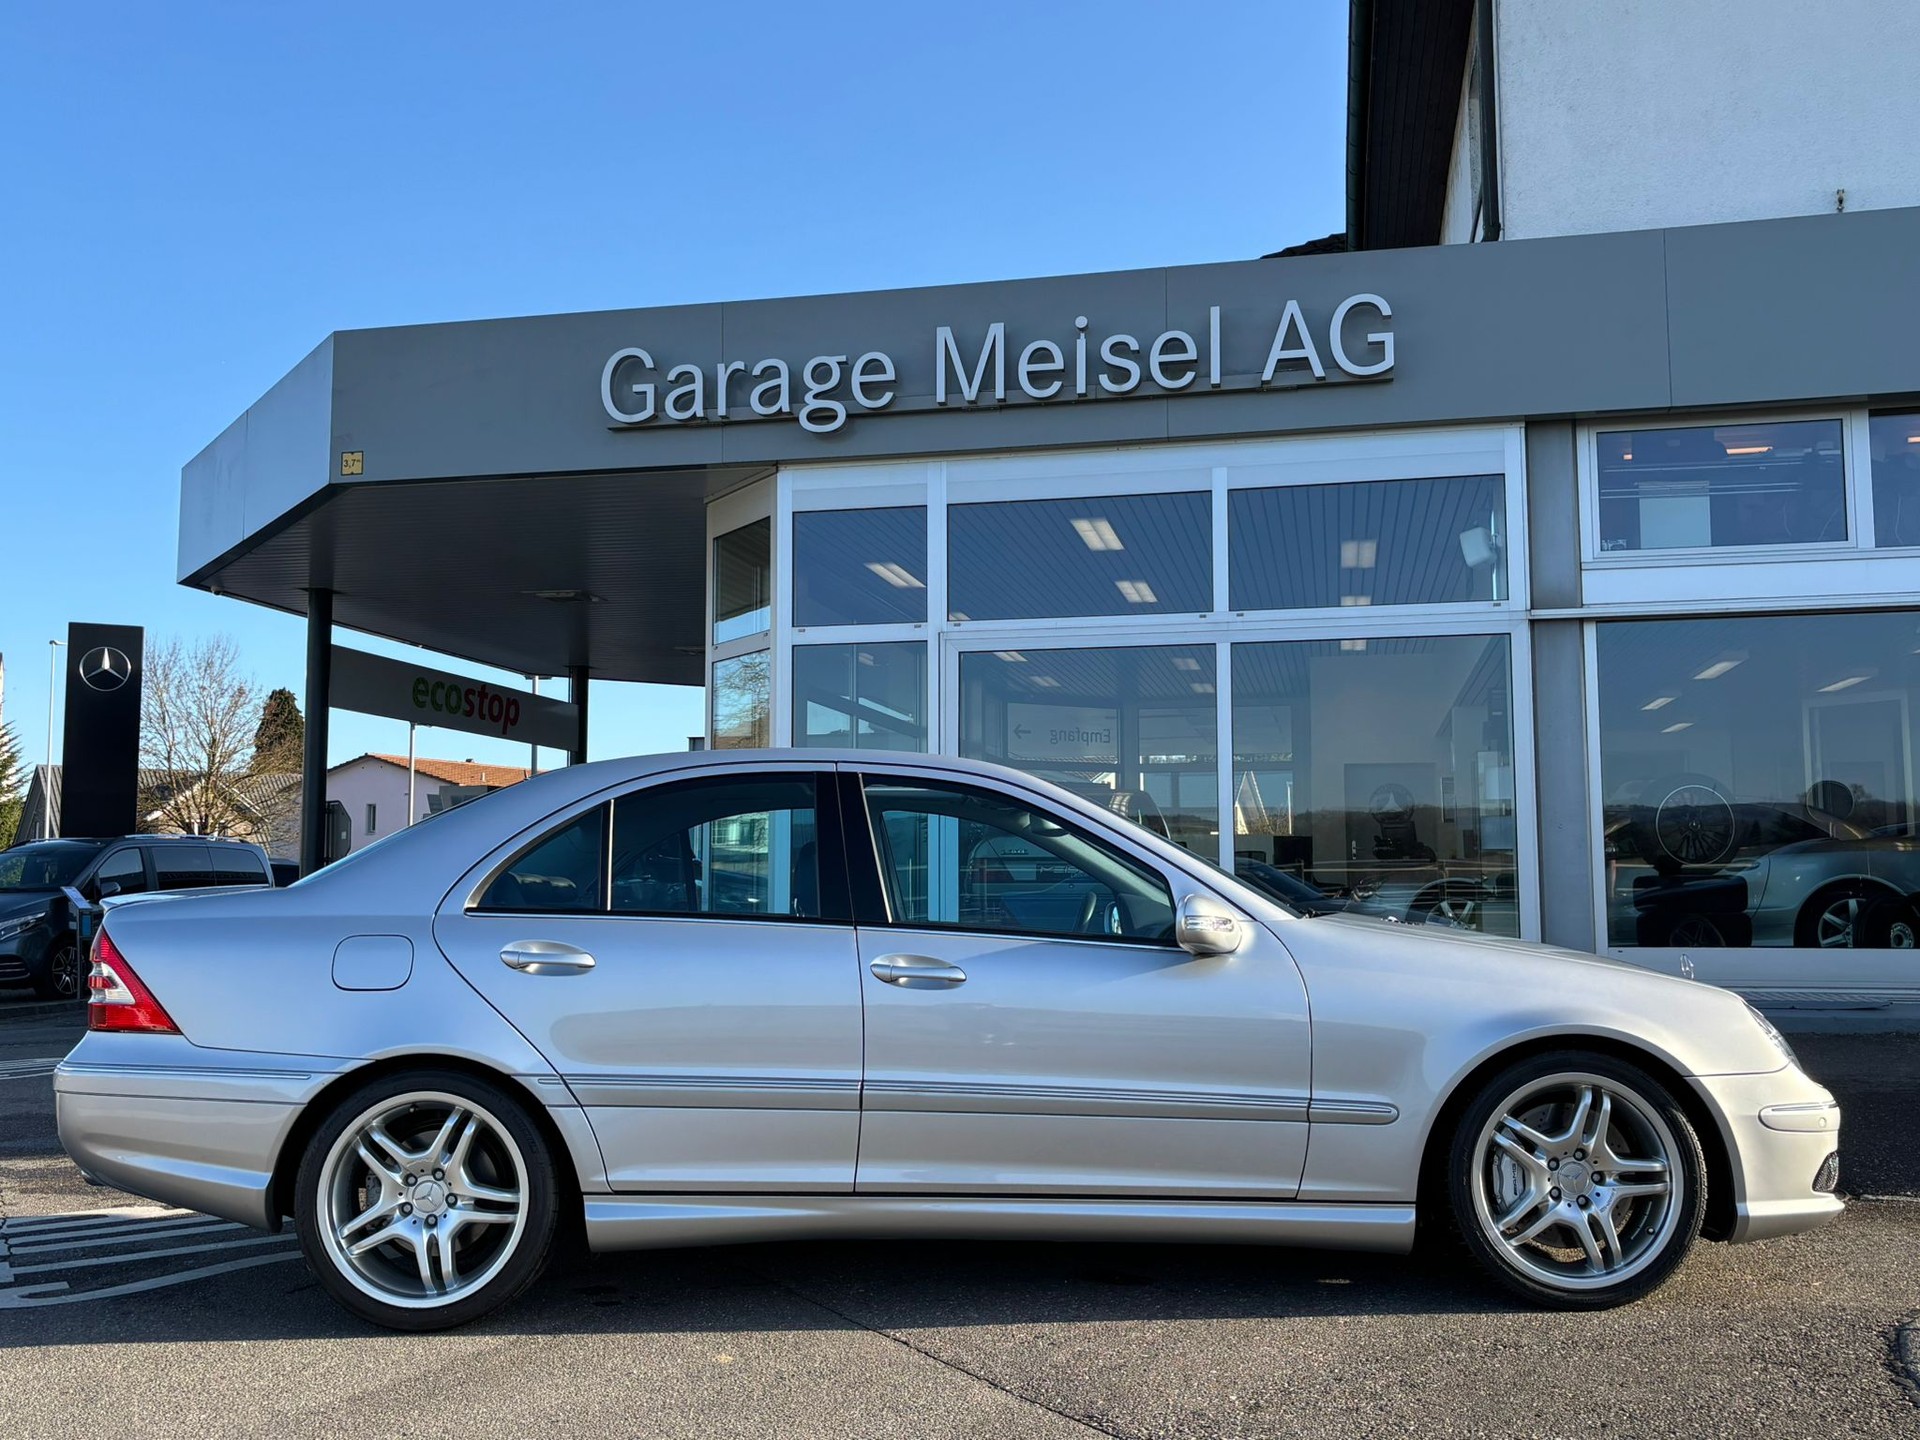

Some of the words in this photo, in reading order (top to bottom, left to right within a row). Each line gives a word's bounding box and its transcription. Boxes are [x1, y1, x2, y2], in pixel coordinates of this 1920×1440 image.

[601, 347, 897, 434] Garage
[936, 305, 1221, 405] Meisel
[1261, 292, 1396, 382] AG
[412, 676, 520, 735] ecostop
